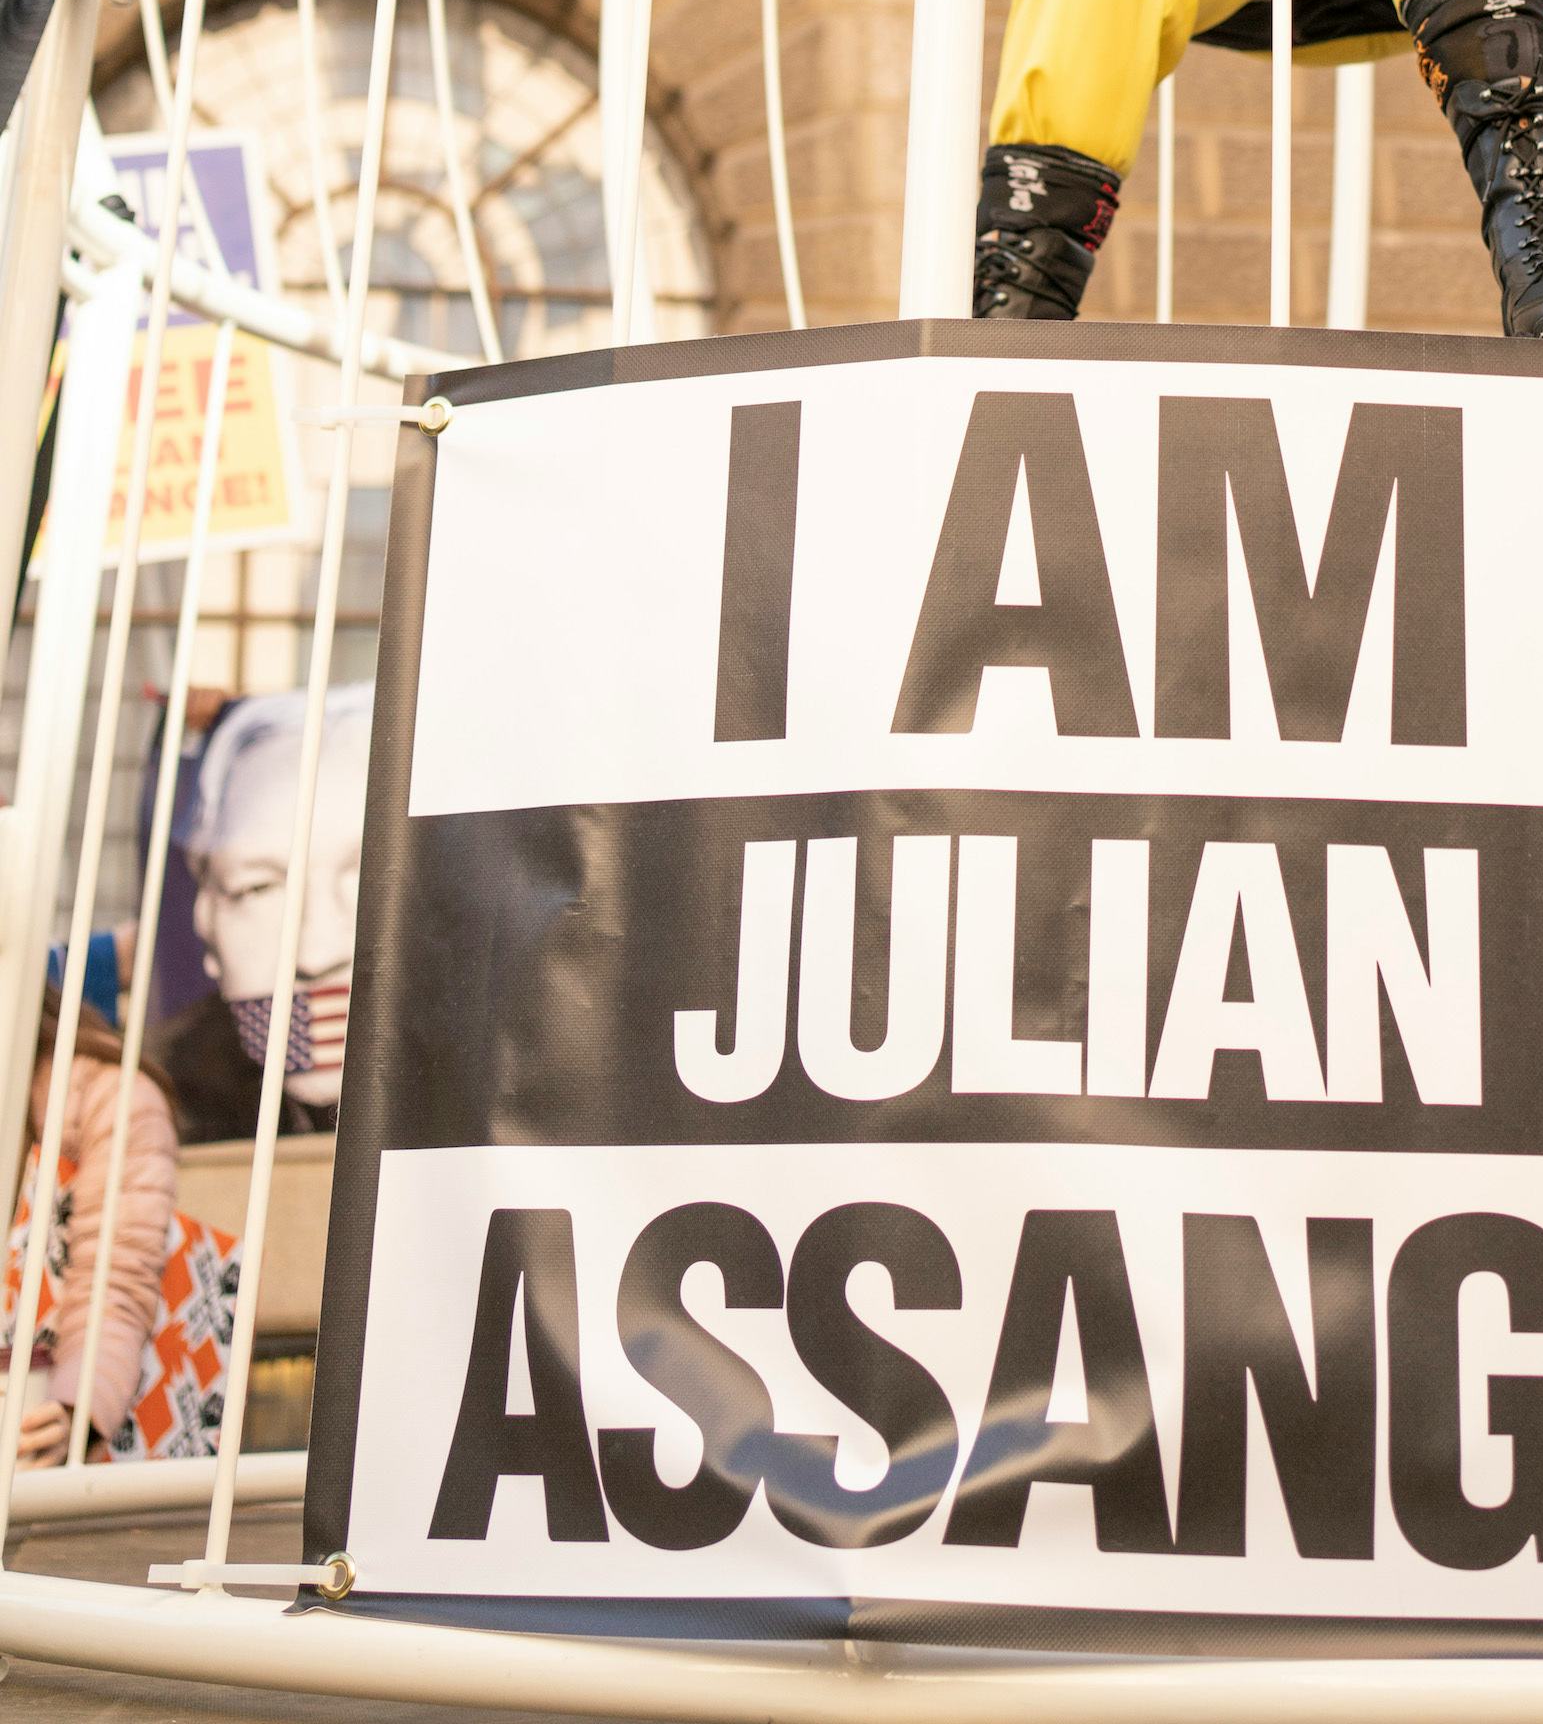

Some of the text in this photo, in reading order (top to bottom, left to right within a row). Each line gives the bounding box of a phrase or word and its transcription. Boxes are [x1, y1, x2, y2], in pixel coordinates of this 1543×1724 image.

[714, 390, 1468, 747] I AM
[673, 833, 1483, 1106] JULIAN
